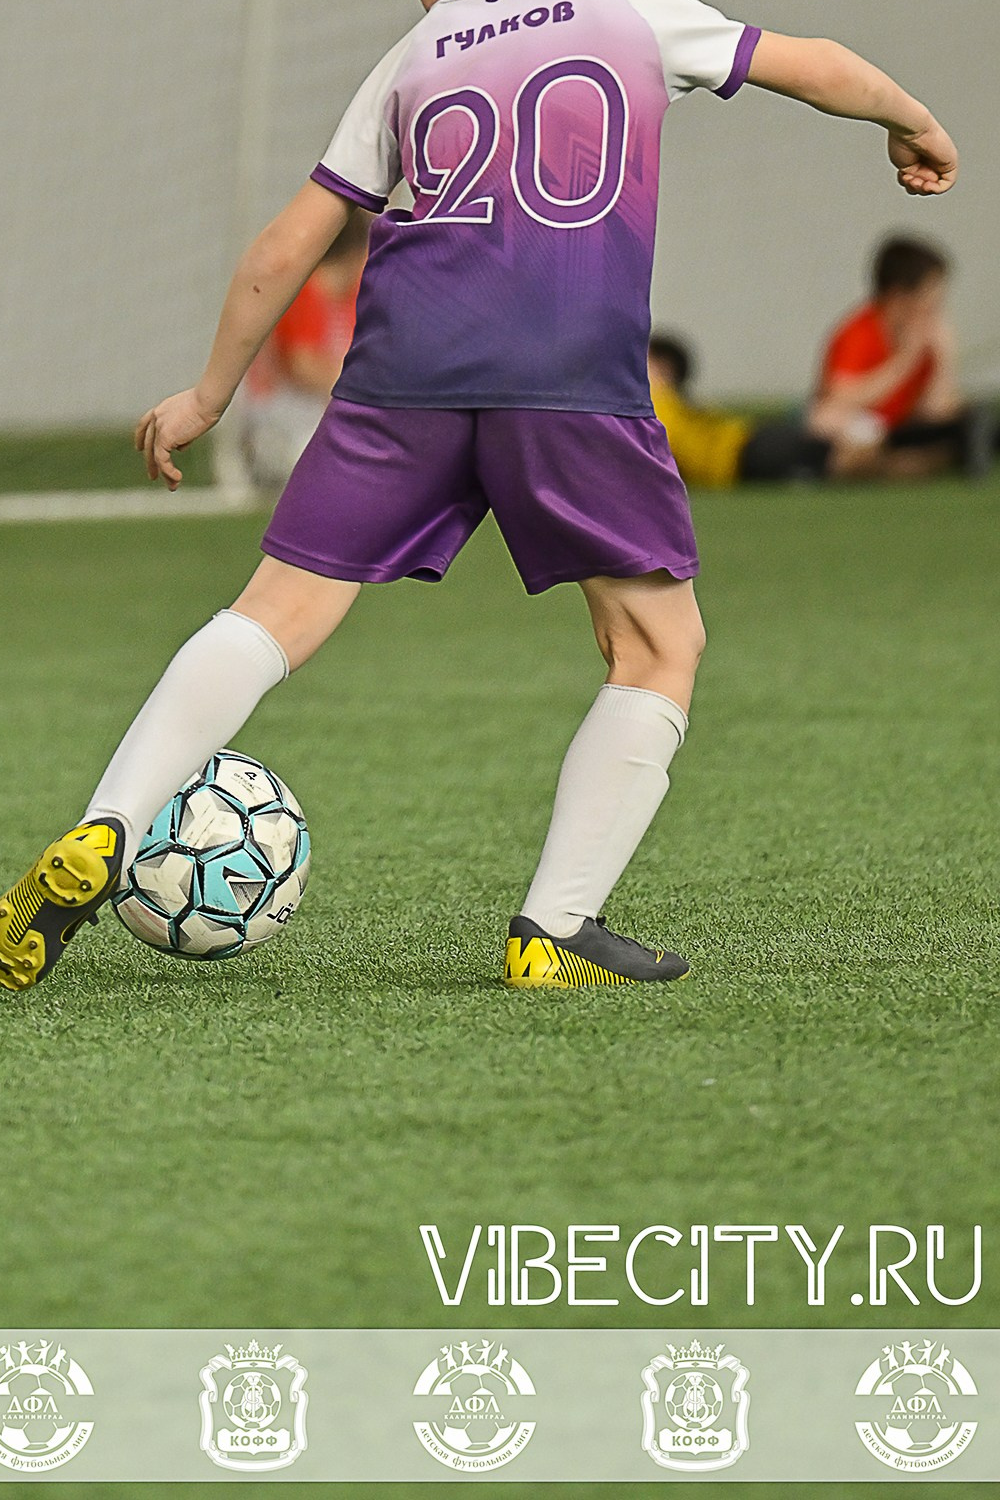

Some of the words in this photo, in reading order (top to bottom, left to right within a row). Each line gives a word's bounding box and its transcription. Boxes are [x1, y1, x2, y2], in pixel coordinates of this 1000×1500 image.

[435, 0, 575, 59] ГУЛКОВ
[396, 54, 630, 229] 20
[244, 771, 257, 781] 4
